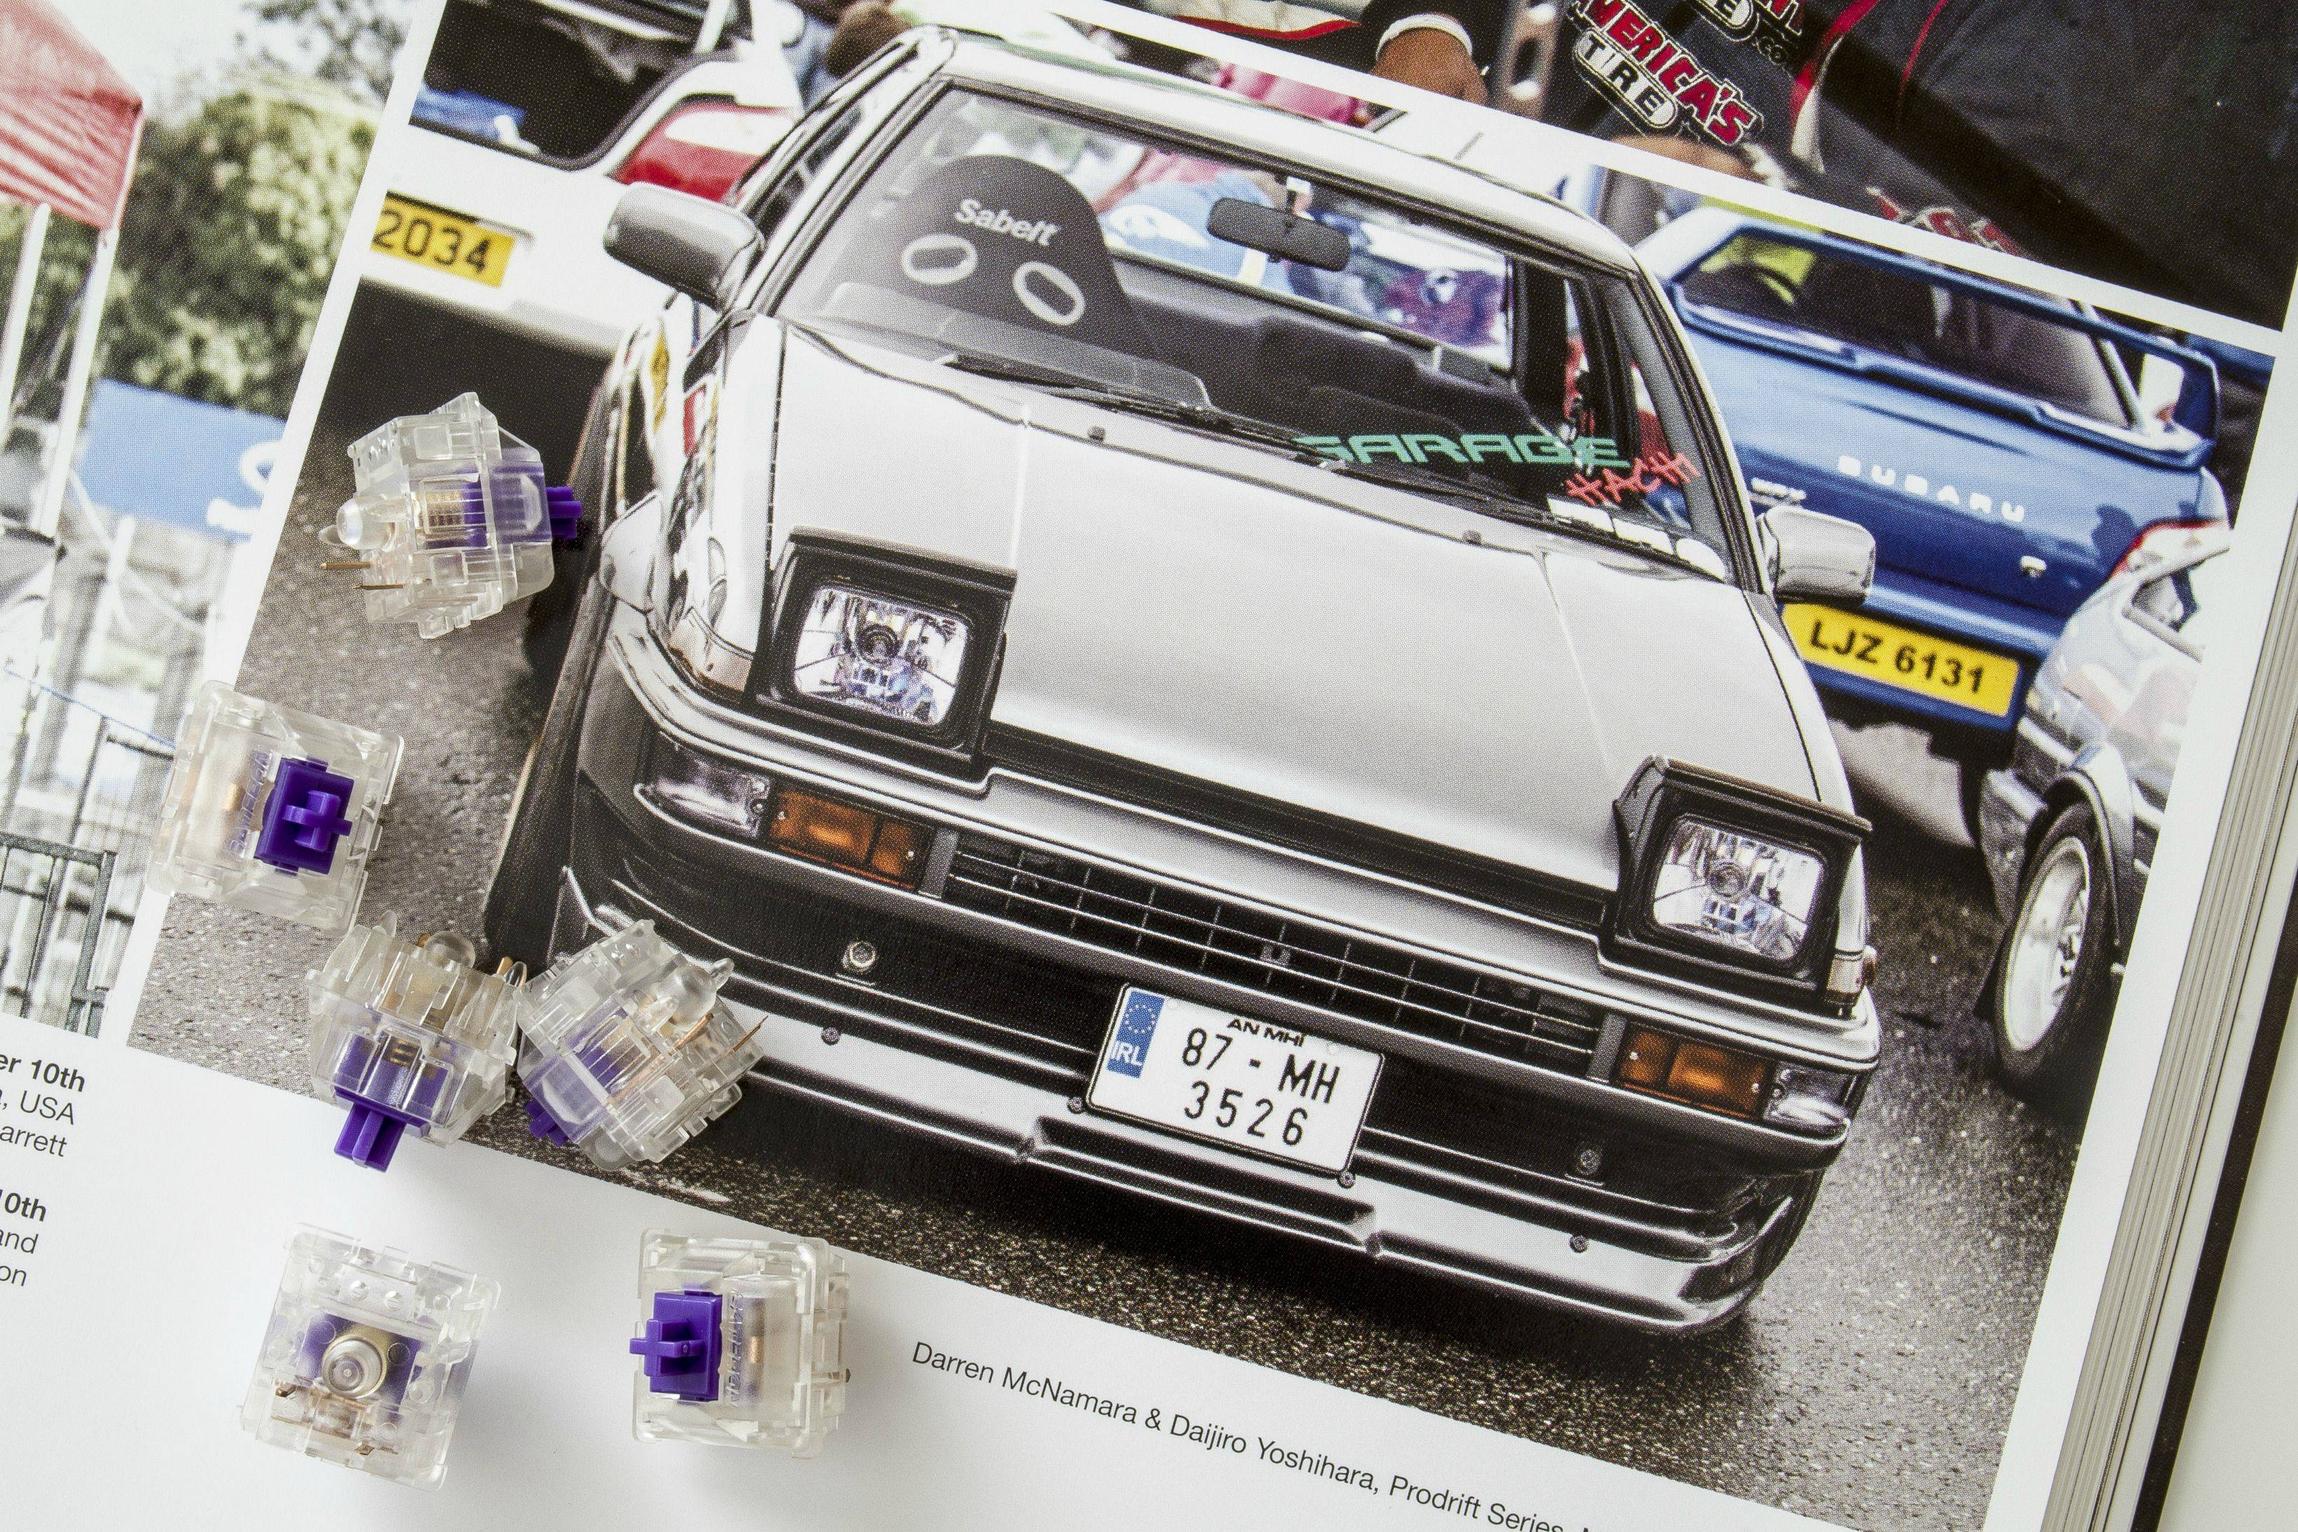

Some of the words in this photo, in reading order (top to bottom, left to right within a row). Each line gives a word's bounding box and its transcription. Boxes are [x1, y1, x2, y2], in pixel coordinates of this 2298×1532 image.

[1576, 0, 1757, 145] MERICA'S
[372, 208, 490, 274] 2034
[1291, 434, 1631, 468] GARAGE
[1810, 619, 1883, 665] LJZ
[1895, 644, 1984, 693] 6131
[1227, 1019, 1259, 1035] AN
[31, 1059, 85, 1093] 10th
[1110, 1041, 1143, 1067] IRL
[1182, 1028, 1233, 1070] 87
[1278, 1054, 1341, 1104] MH
[20, 1090, 75, 1125] USA
[1184, 1080, 1308, 1146] 3526
[0, 1189, 47, 1222] 0th
[912, 1341, 994, 1383] Darren
[1002, 1366, 1137, 1424] McNamara
[1145, 1408, 1161, 1431] &
[1170, 1414, 1247, 1451] Daijiro
[1257, 1437, 1379, 1495] Yoshihara,
[1389, 1475, 1481, 1519] Prodrift
